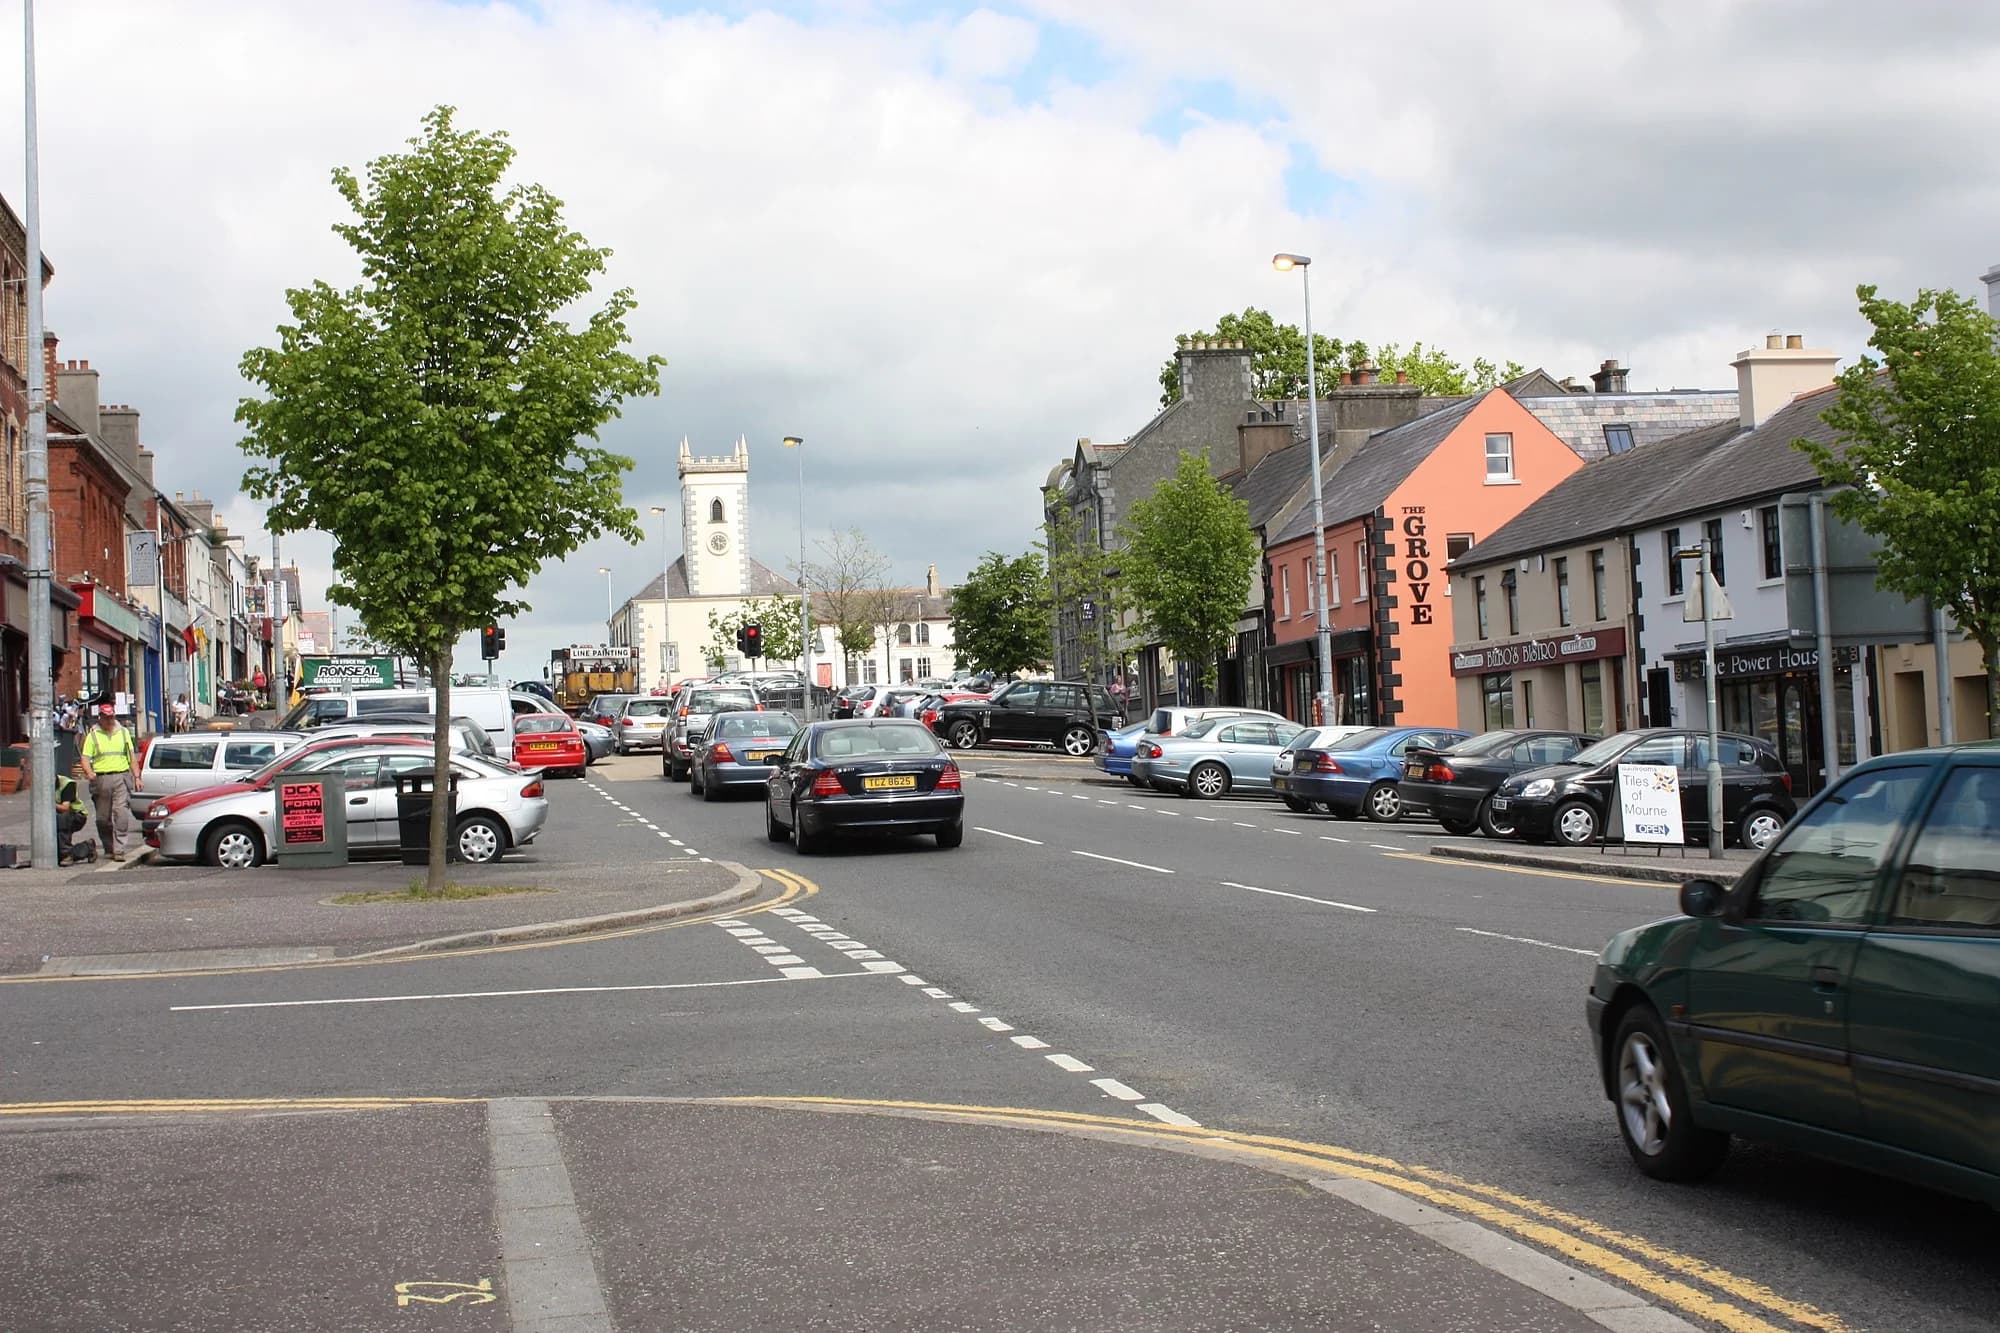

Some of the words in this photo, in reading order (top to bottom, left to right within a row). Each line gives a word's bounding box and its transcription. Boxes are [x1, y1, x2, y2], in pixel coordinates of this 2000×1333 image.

[1401, 507, 1426, 515] THE
[1403, 515, 1433, 625] GROVE
[592, 649, 628, 657] PAINTING
[1522, 641, 1557, 663] BISTRO
[1700, 659, 1725, 676] Te
[1731, 655, 1772, 673] Power
[1778, 648, 1819, 668] Hous
[318, 665, 379, 677] RONSEAL
[870, 778, 886, 787] TCZ
[888, 777, 911, 785] 8625
[1623, 774, 1649, 787] Tiles
[284, 785, 318, 794] DCX
[1632, 789, 1642, 801] of
[1625, 804, 1668, 817] Mourne
[1638, 824, 1665, 834] OPEN
